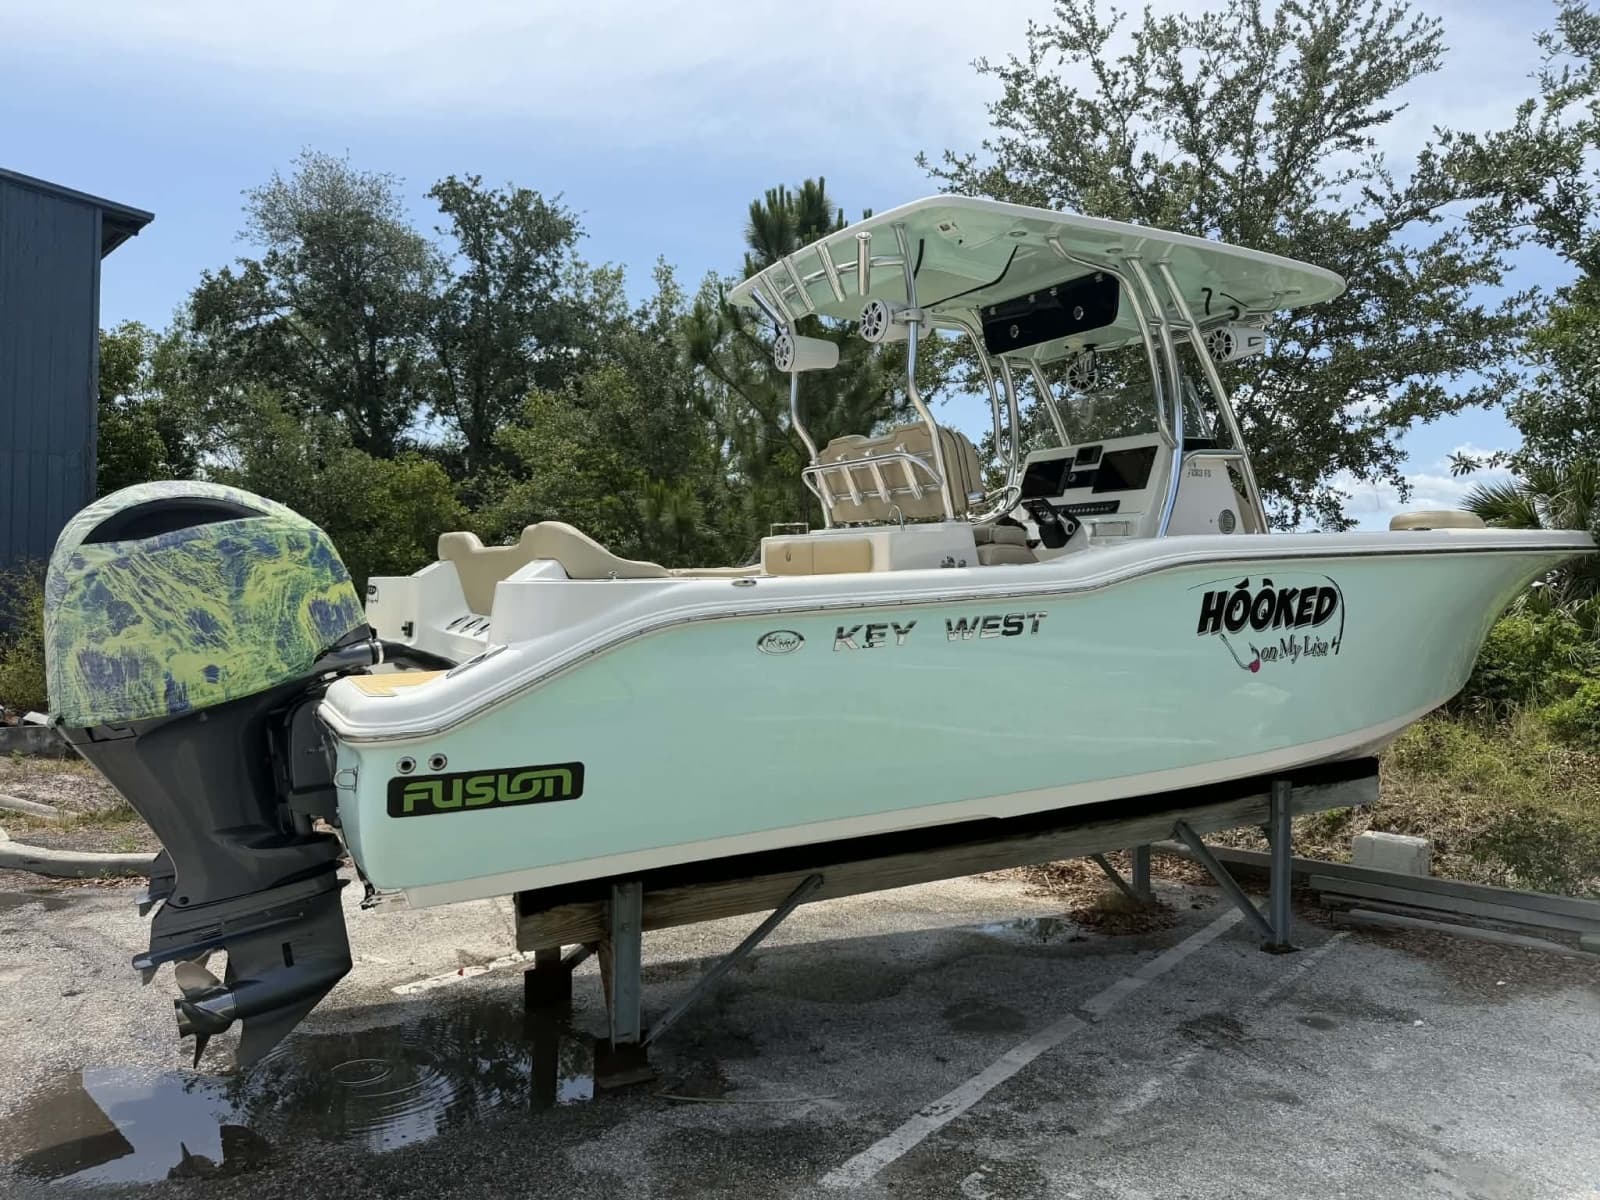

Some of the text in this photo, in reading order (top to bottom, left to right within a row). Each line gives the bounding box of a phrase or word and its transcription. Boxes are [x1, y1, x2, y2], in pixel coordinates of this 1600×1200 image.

[832, 611, 1049, 651] KEY WEST
[1197, 584, 1339, 636] HOOKED
[1260, 634, 1329, 664] on My Lisa
[403, 768, 573, 812] FUSION
